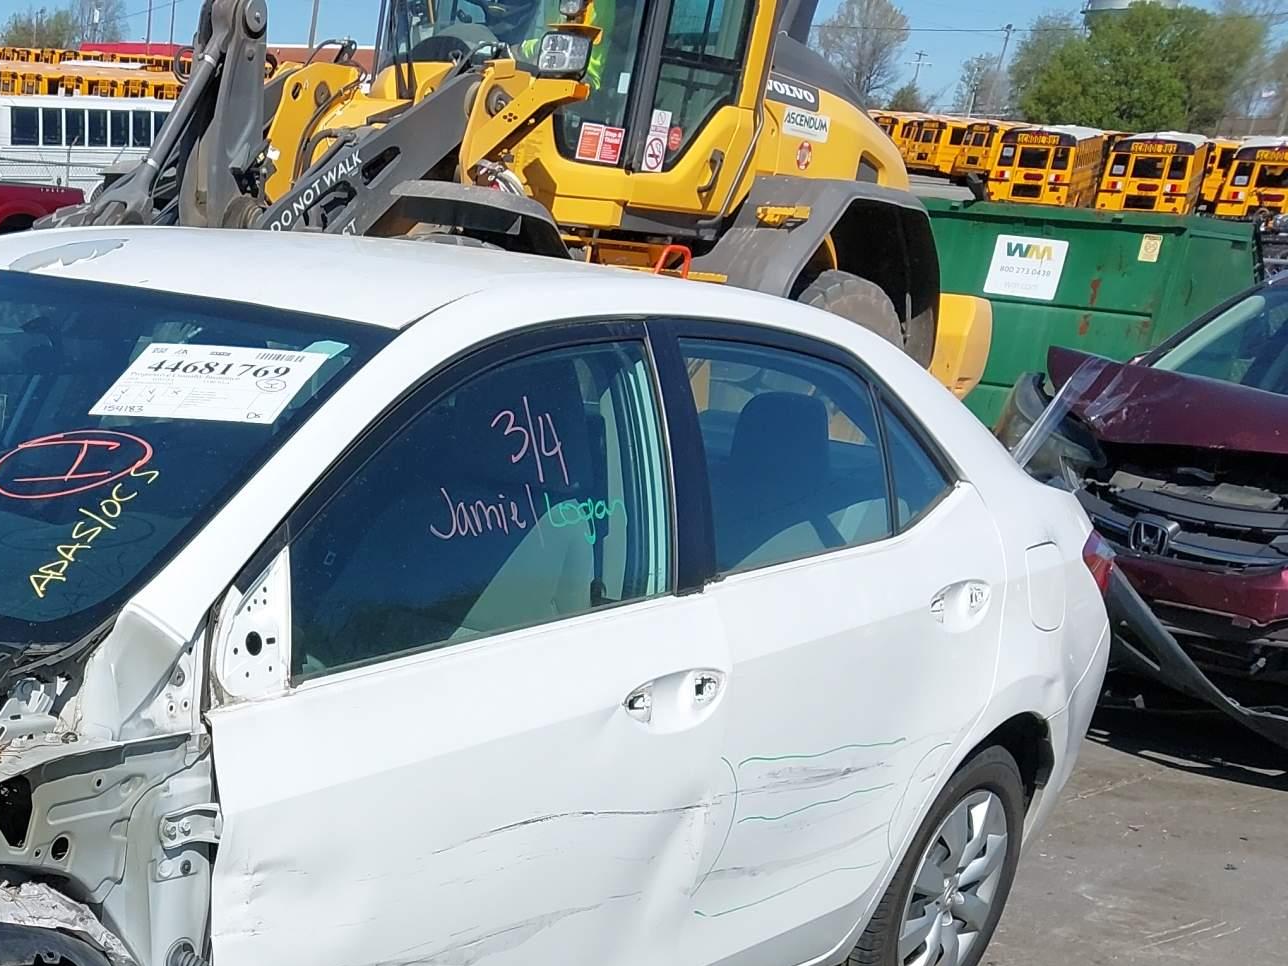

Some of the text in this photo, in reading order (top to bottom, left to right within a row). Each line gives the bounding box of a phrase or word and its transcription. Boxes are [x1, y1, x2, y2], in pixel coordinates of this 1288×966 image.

[784, 111, 828, 132] ASCENDUM
[1132, 143, 1160, 153] SCHOOL
[270, 149, 362, 232] DO NOT WALK
[1006, 242, 1053, 260] WM
[147, 359, 291, 379] 44681769
[490, 396, 570, 486] 3/4
